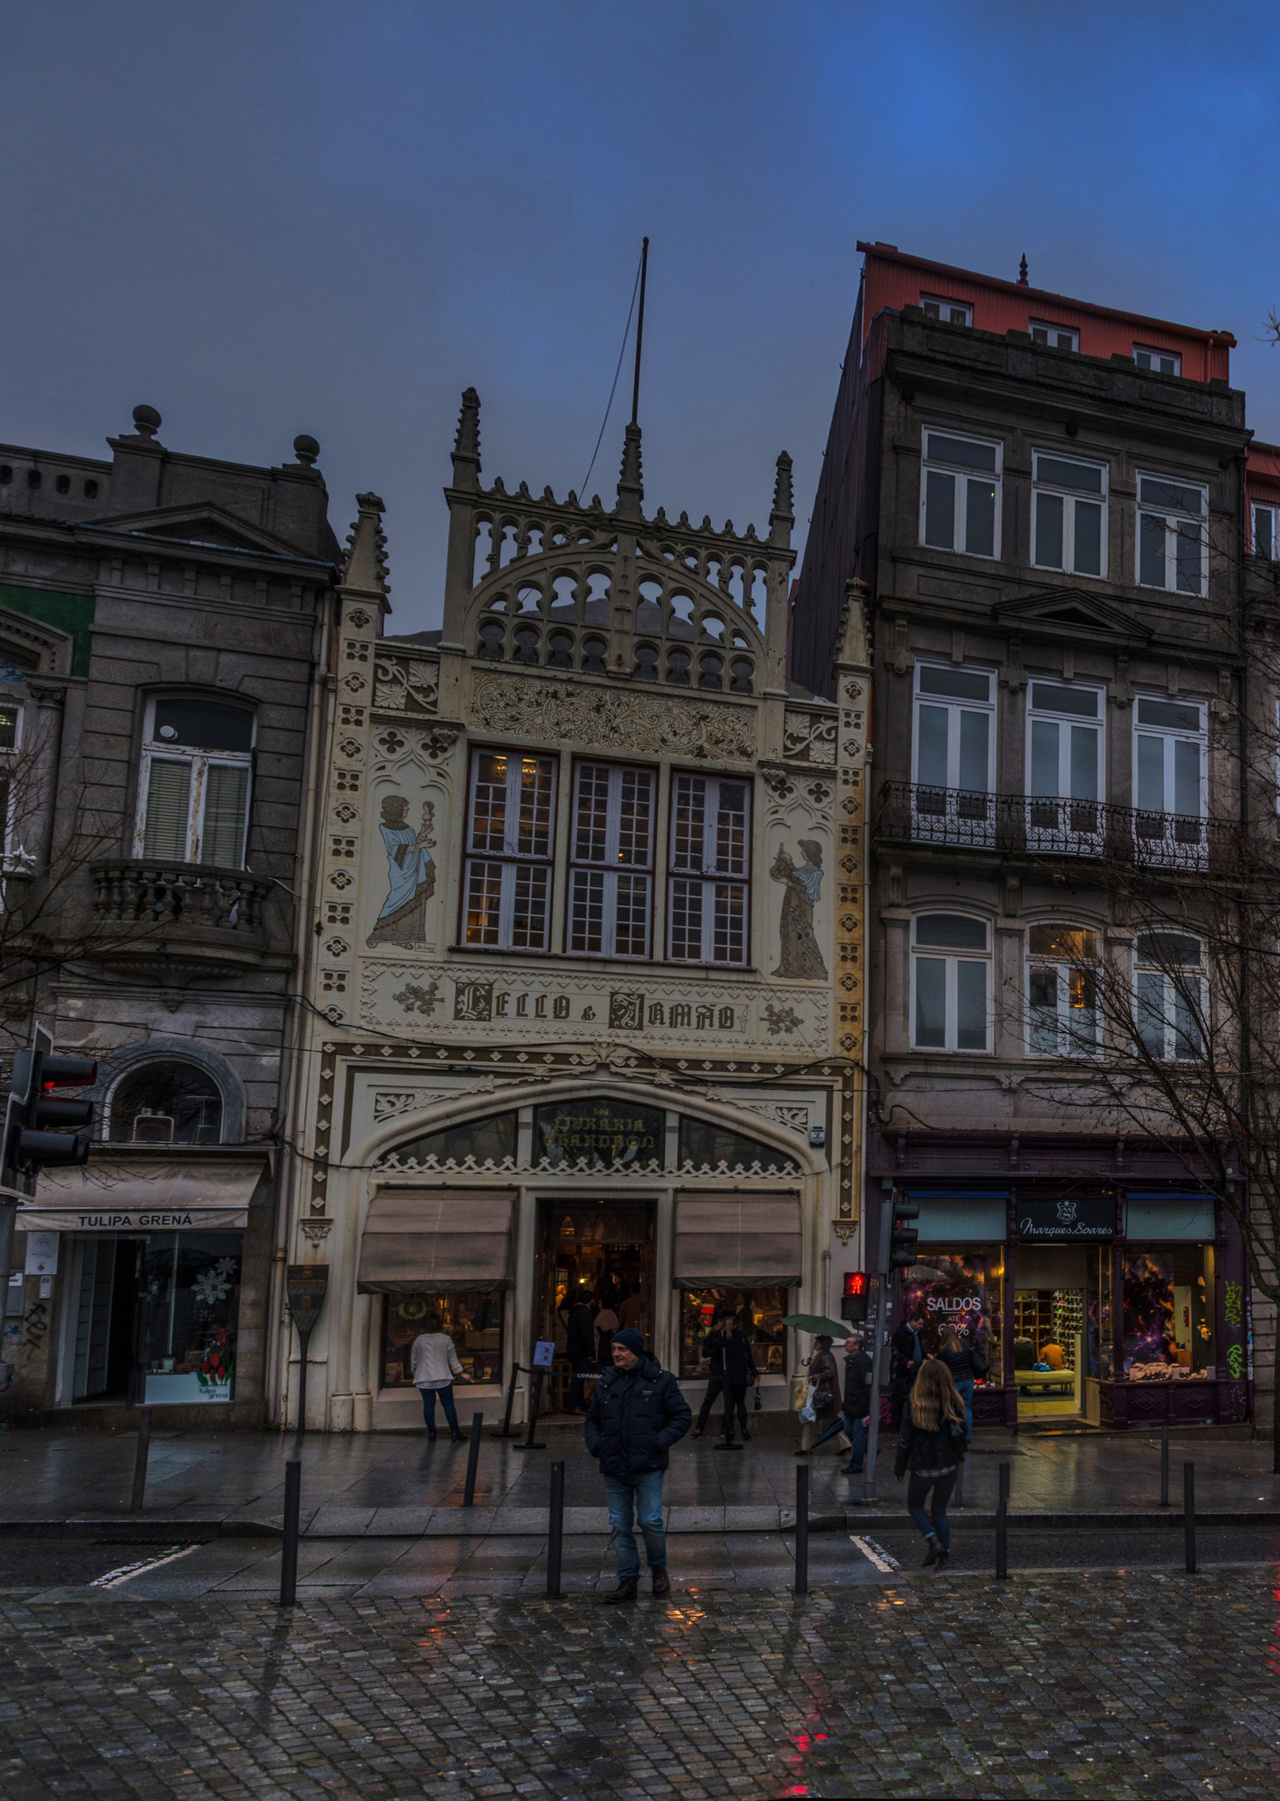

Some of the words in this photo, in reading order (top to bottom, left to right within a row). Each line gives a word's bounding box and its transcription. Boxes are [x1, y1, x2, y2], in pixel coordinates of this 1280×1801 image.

[581, 1005, 596, 1021] &
[78, 1216, 132, 1227] TULIPA
[139, 1212, 192, 1226] GRENÁ
[1020, 1217, 1072, 1237] Marques
[1072, 1221, 1112, 1235] Soares
[926, 1296, 981, 1311] SALDOS
